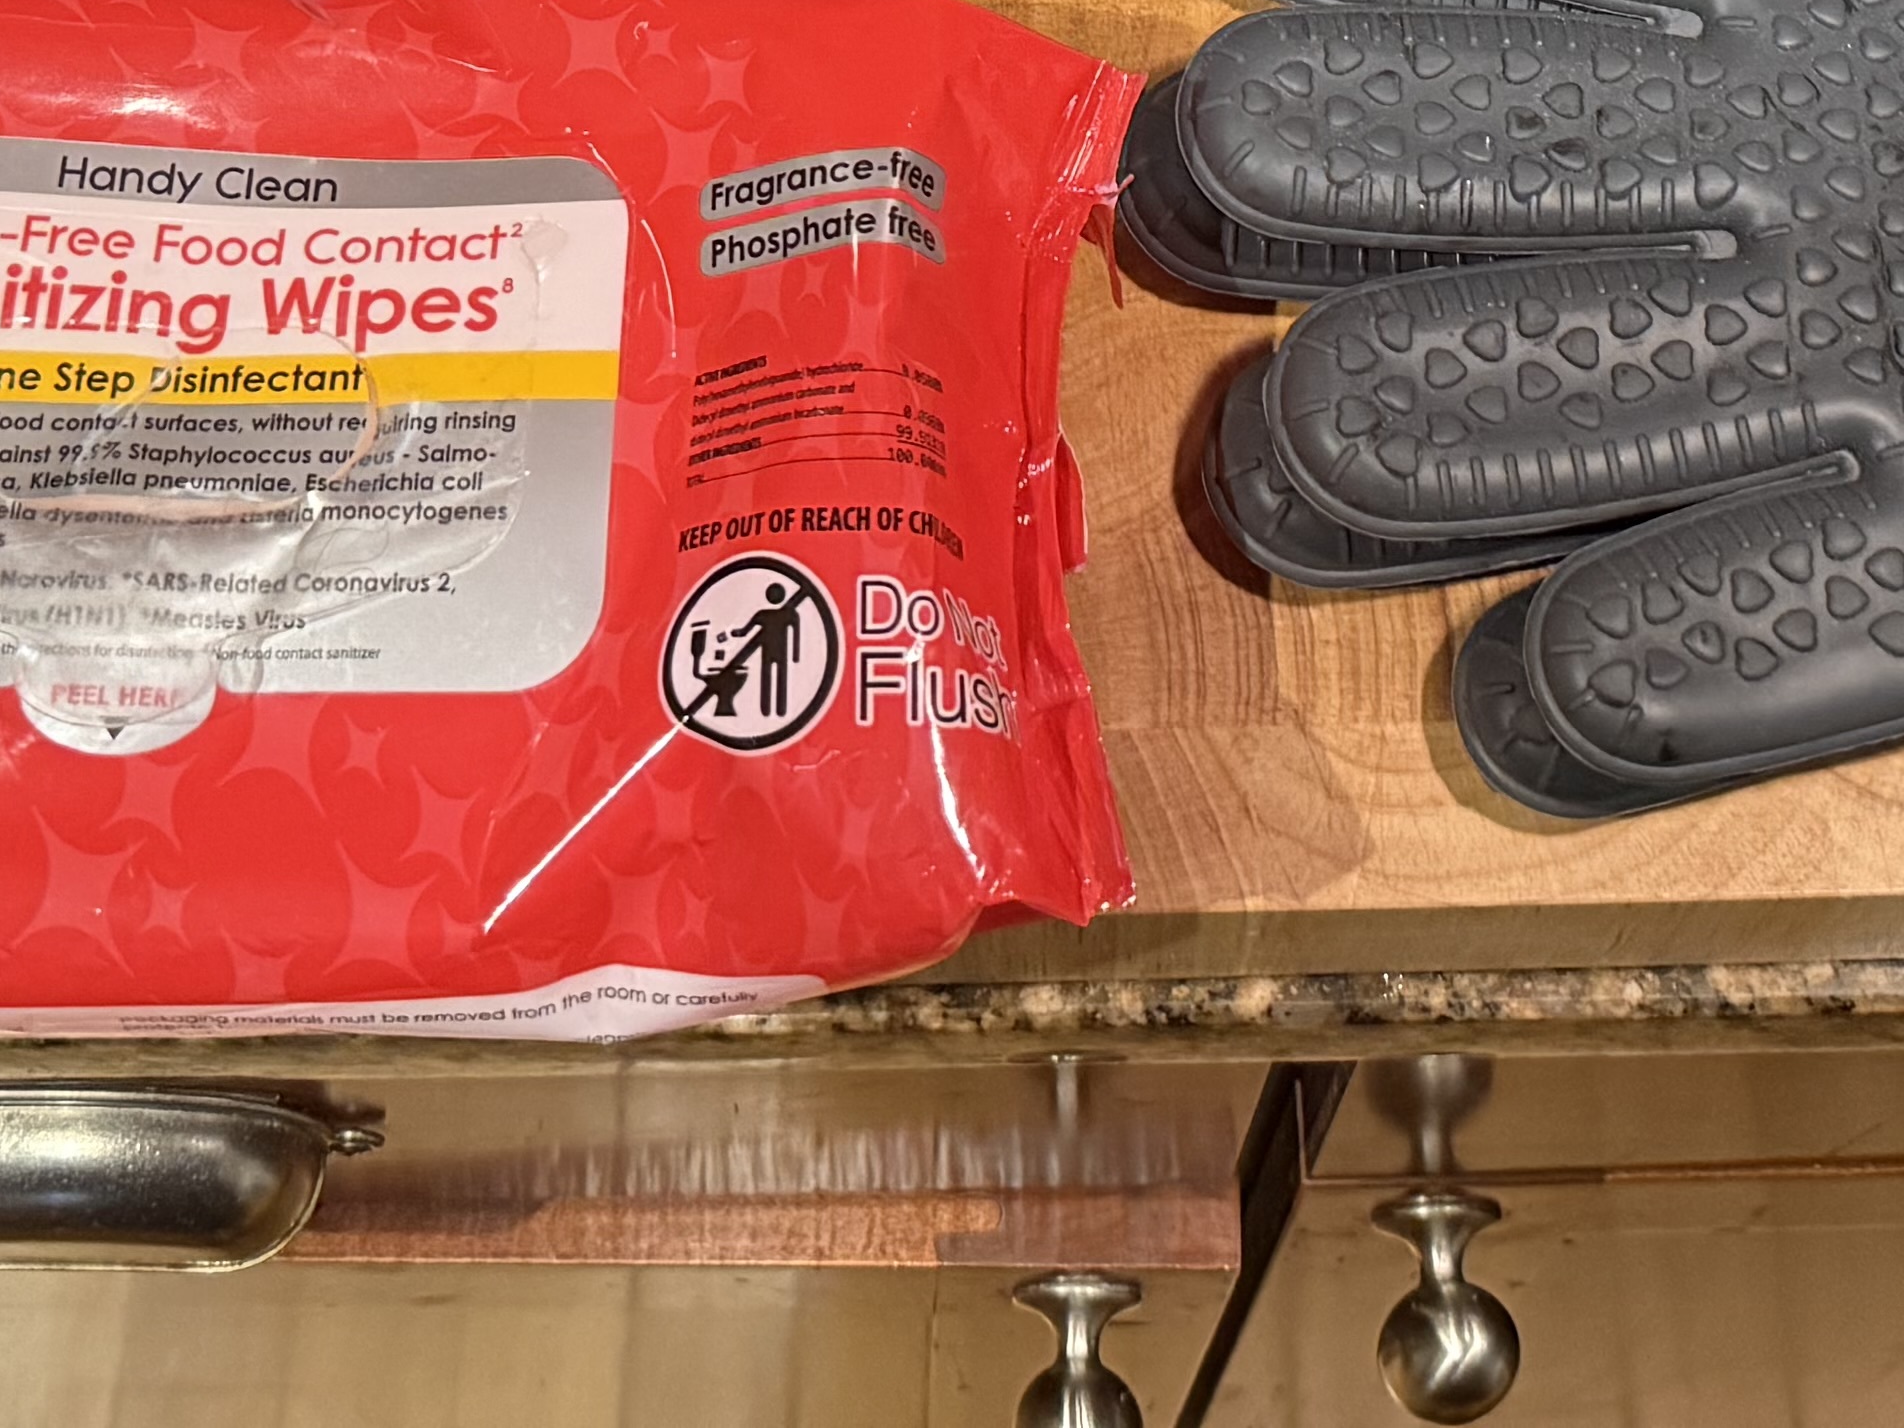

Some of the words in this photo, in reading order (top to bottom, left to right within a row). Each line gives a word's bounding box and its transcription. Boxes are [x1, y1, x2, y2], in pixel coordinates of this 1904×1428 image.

[58, 155, 203, 204] Handy
[215, 167, 338, 203] Clean
[711, 151, 935, 211] Fragrance-free
[153, 223, 286, 267] Food
[711, 208, 876, 268] Phosphate
[887, 205, 936, 251] free
[54, 362, 135, 398] Step
[150, 363, 365, 394] Disinfectant
[678, 521, 721, 553] KEEP
[726, 511, 766, 541] OUT
[768, 508, 795, 533] OF
[801, 507, 871, 531] REACH
[877, 507, 904, 531] OF
[856, 574, 945, 640] Do
[943, 587, 1008, 672] Not
[856, 646, 1022, 748] Flush
